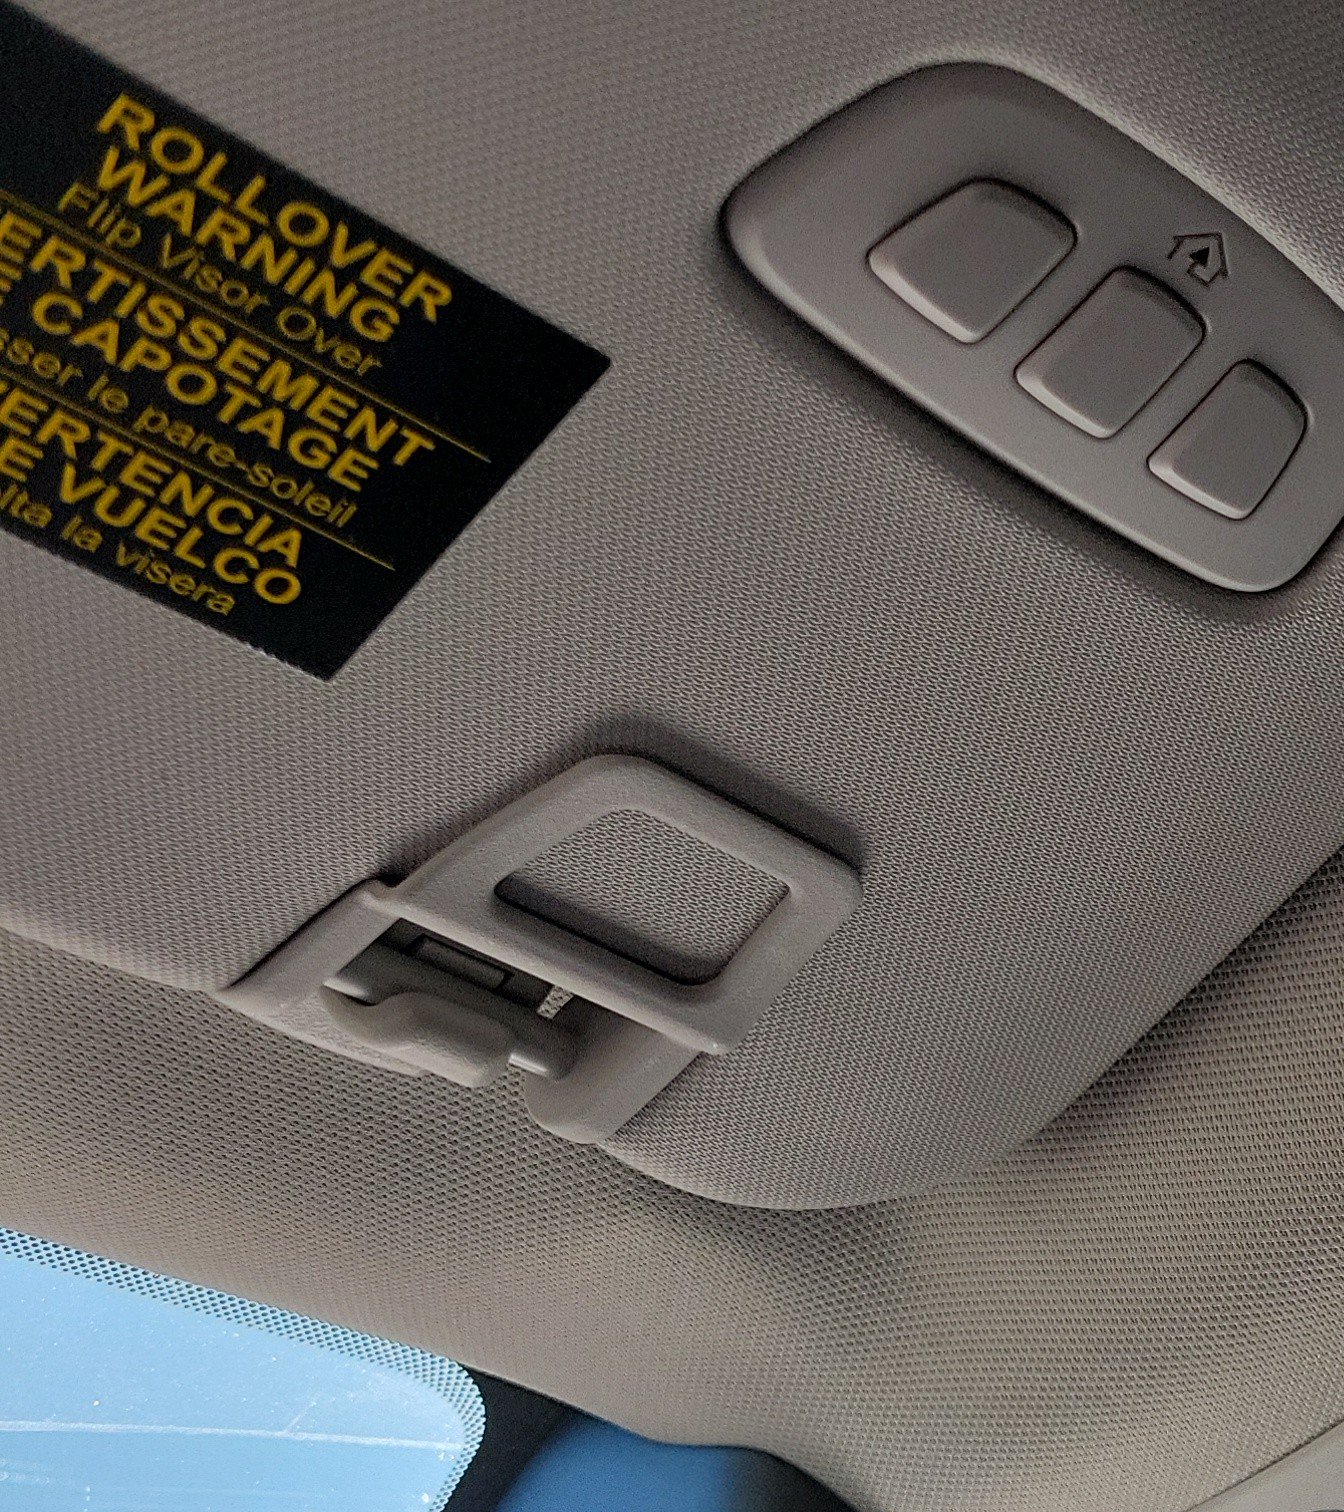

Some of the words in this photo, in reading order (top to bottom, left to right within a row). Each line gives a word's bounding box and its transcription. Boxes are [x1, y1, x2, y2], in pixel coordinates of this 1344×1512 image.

[57, 182, 142, 249] Flip
[162, 232, 271, 314] Visor
[276, 306, 382, 377] Over
[98, 92, 452, 323] ROLLOVER
[98, 145, 400, 344] WARNING
[0, 378, 302, 569] ERTENCIA
[32, 292, 380, 493] CAPOTAGE
[86, 373, 129, 413] le
[132, 404, 358, 528] pare-soleil
[60, 462, 301, 605] VUELCO
[61, 515, 103, 553] la
[115, 541, 236, 617] visera
